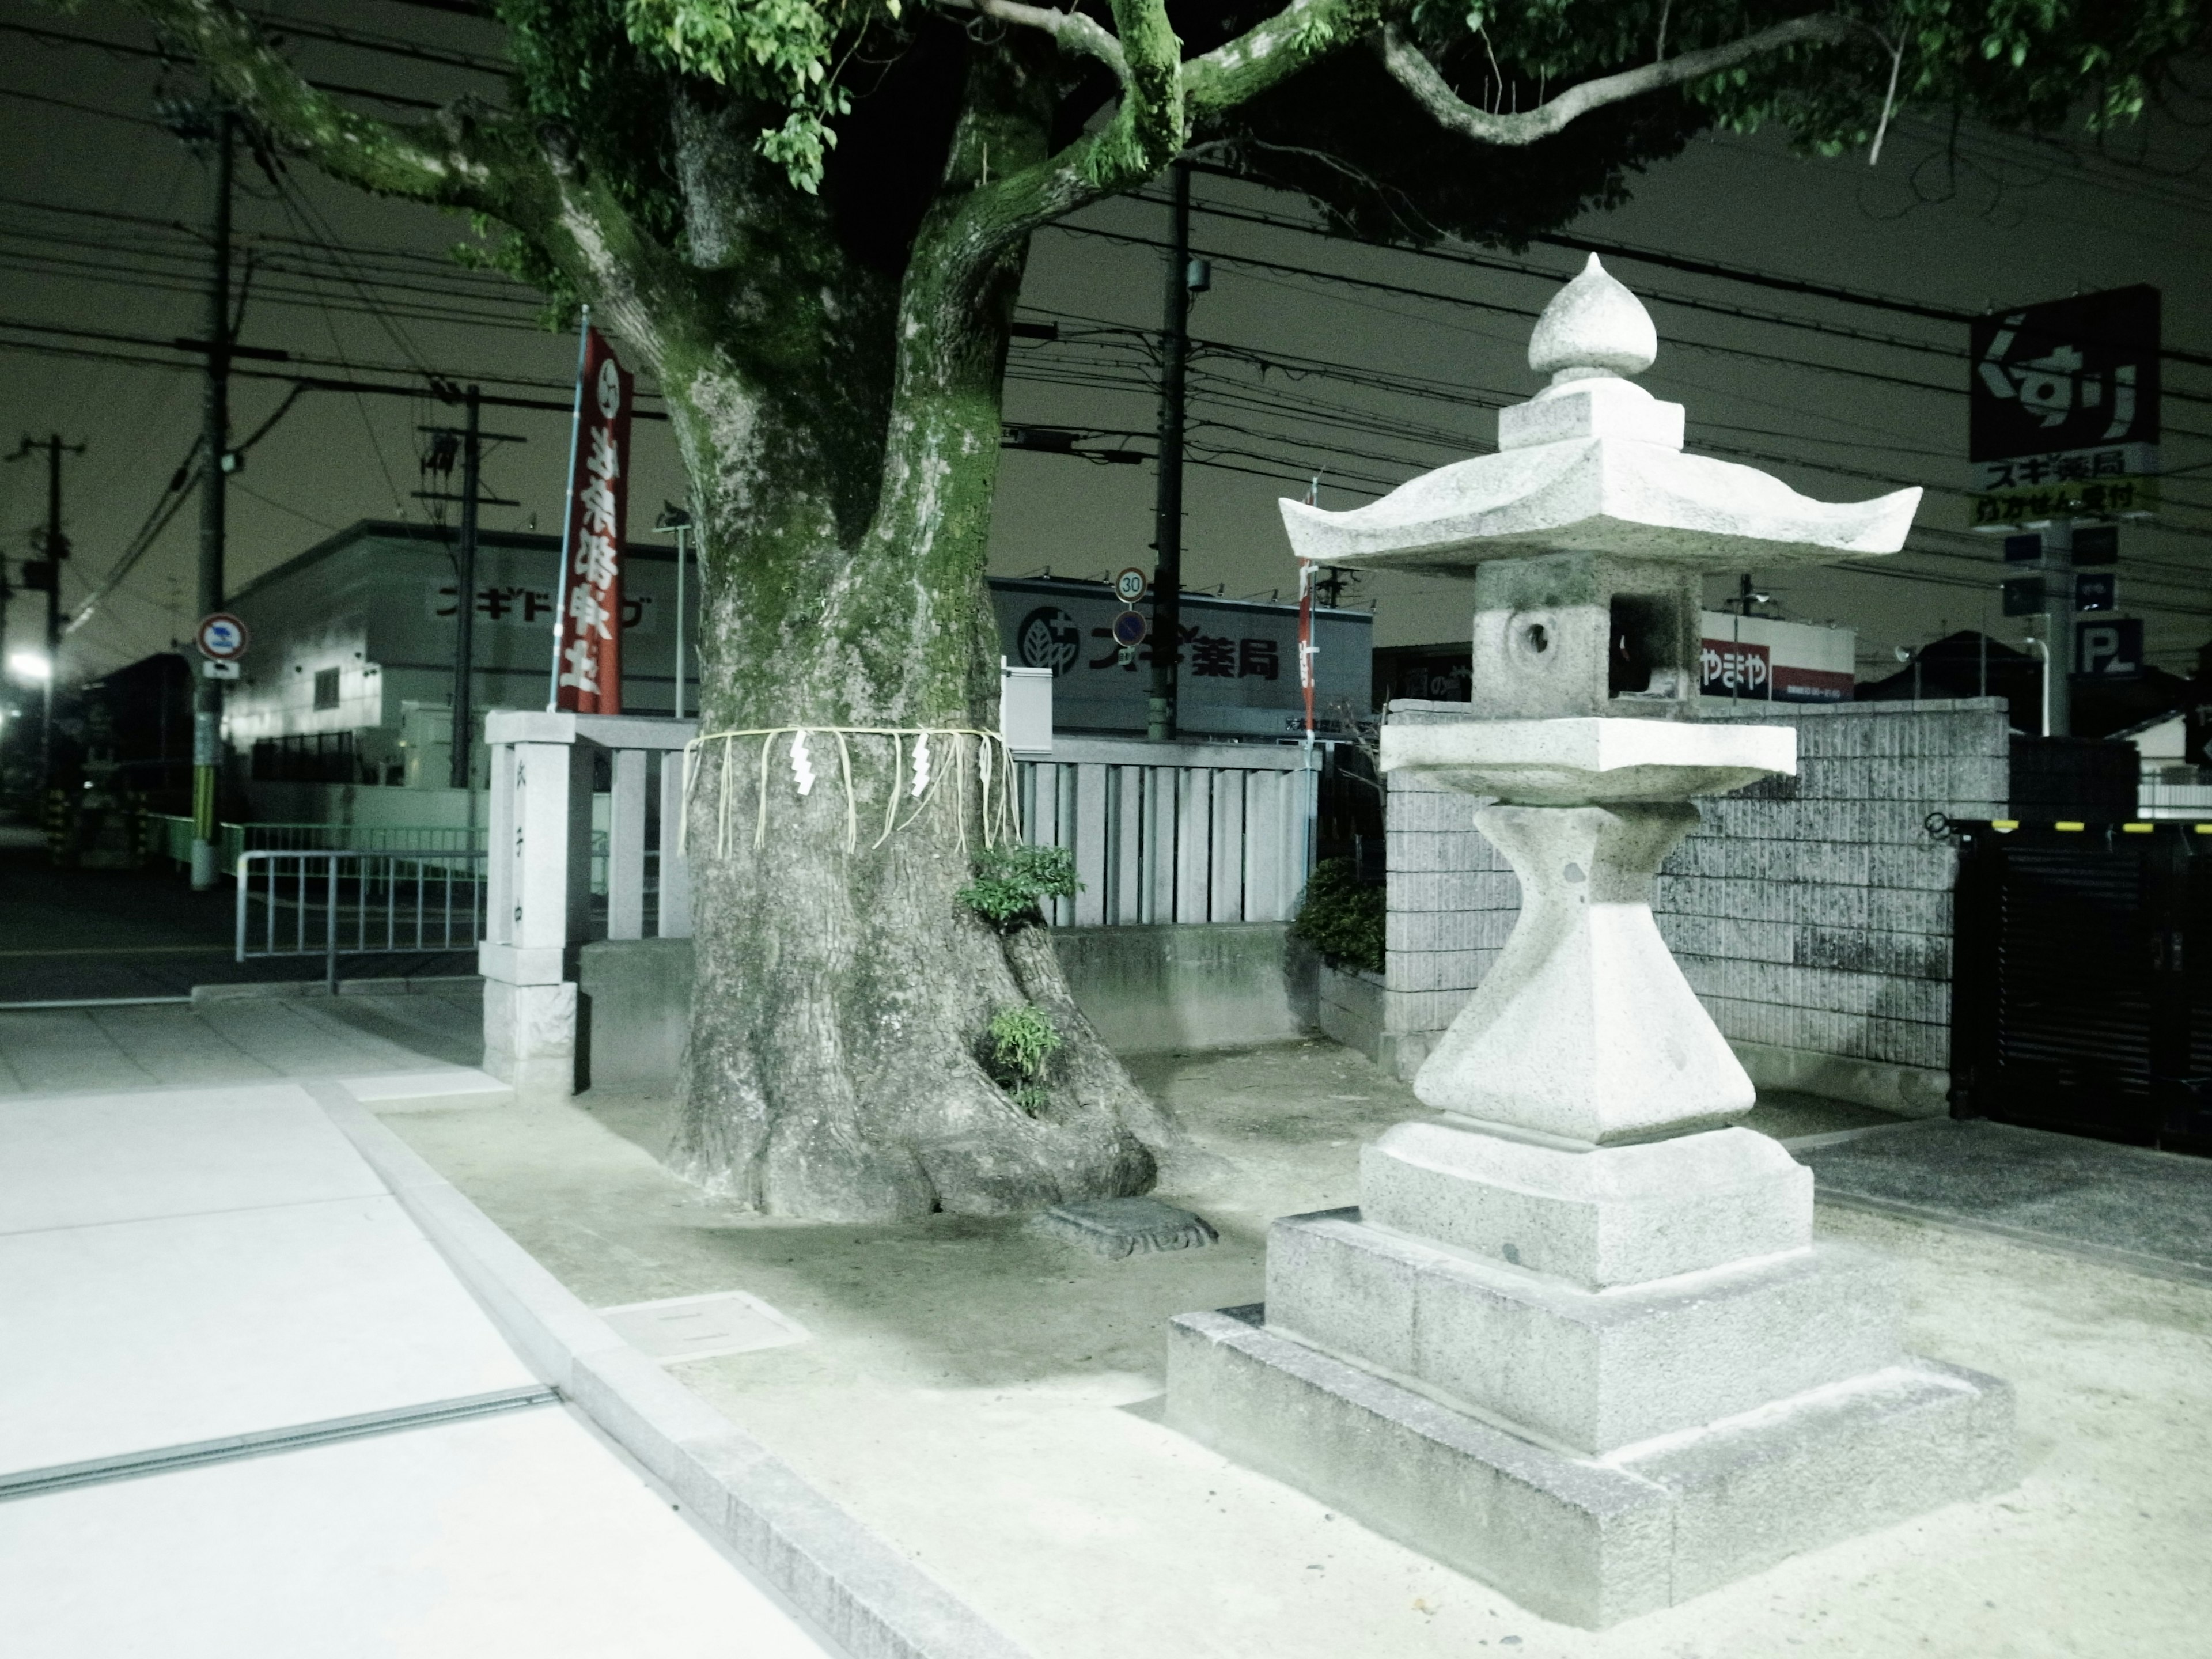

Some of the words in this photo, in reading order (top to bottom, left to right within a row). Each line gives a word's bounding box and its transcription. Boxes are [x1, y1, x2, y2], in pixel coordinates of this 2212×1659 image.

[1978, 313, 2137, 440] くすり
[1986, 450, 2124, 490] スギ薬局
[1123, 577, 1140, 592] 30
[1700, 648, 1767, 690] やまや
[2082, 627, 2119, 672] P
